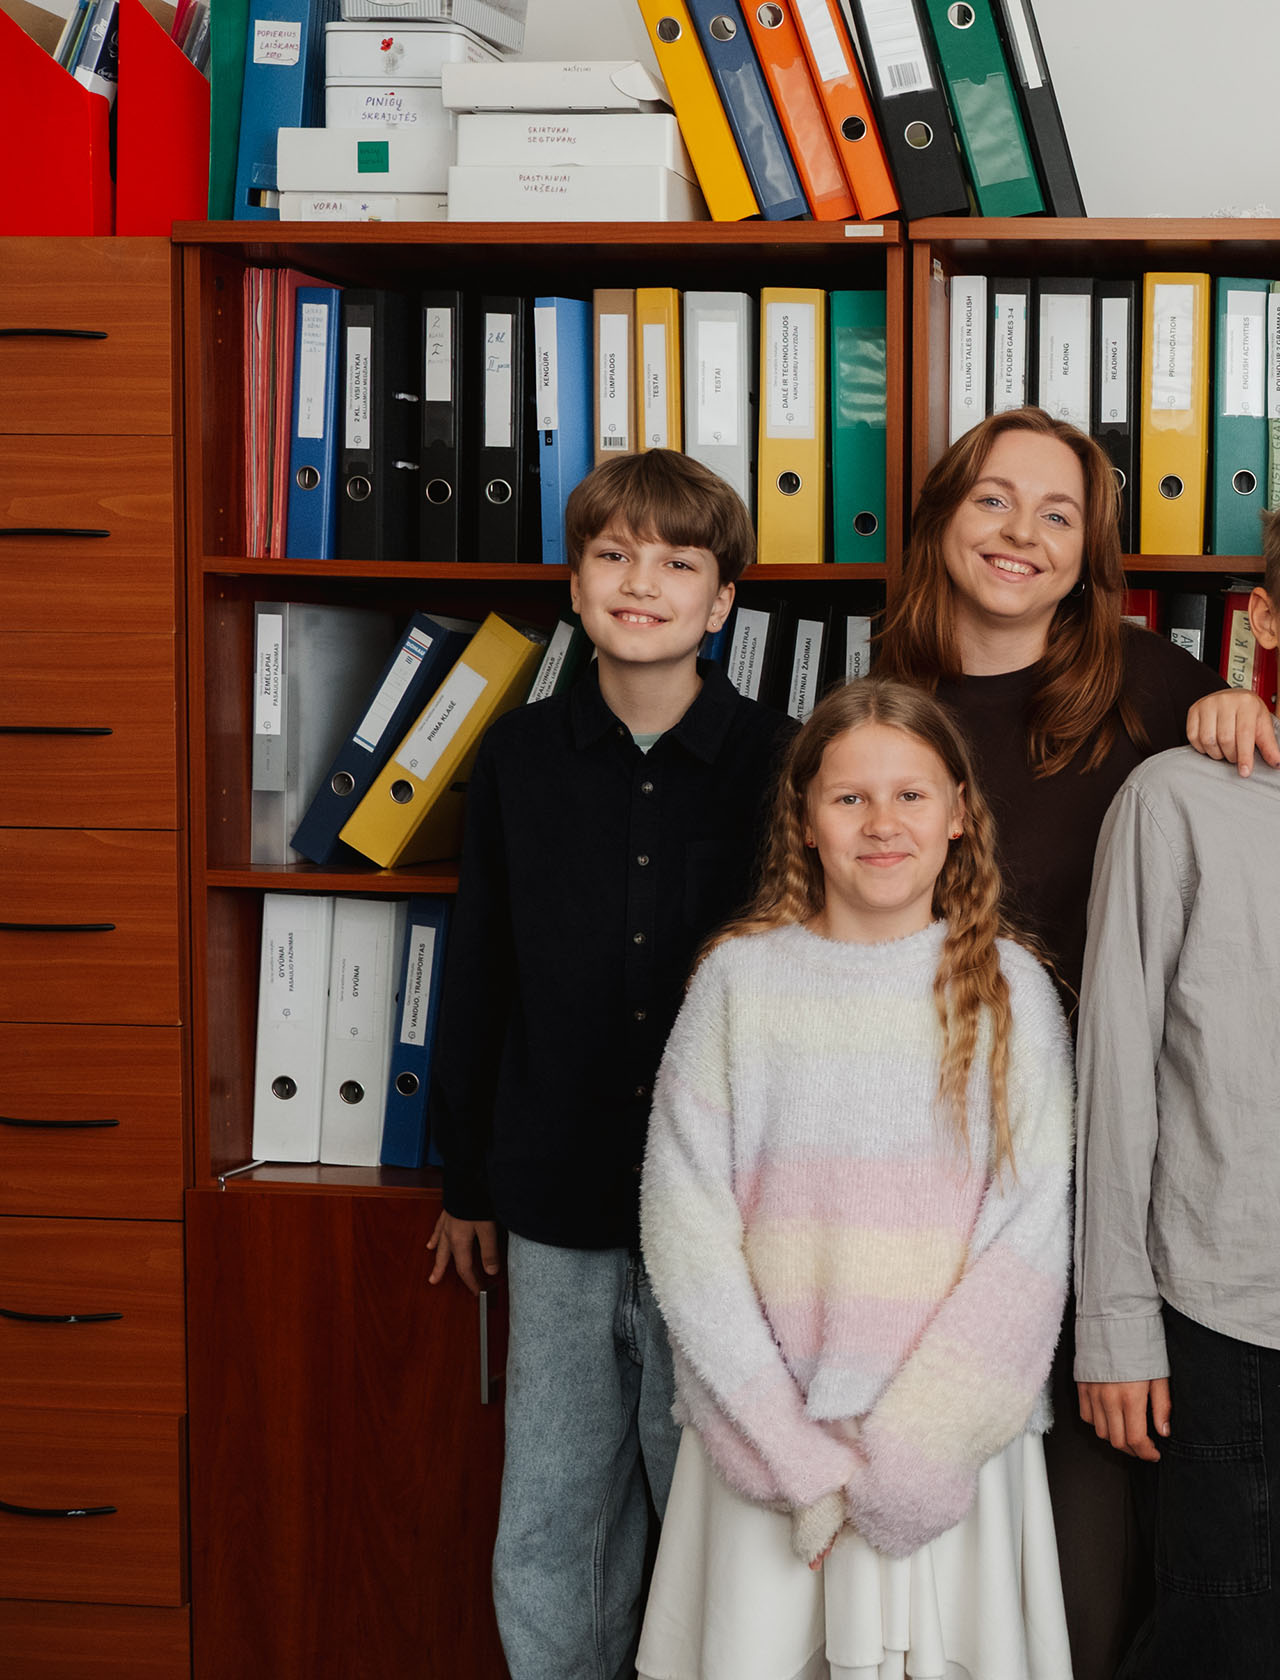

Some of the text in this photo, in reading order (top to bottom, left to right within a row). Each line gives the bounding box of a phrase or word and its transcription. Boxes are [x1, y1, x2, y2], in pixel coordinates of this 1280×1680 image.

[361, 112, 417, 122] SKRAJUTĖS
[365, 97, 402, 111] PINIGŲ
[781, 314, 790, 377] TECHNOLOGIJOS
[965, 295, 974, 392] TELLING TALES IN ENGLISH
[1062, 342, 1070, 376] READING
[1168, 315, 1178, 379] PRONUNCIATION
[1241, 316, 1251, 390] ENGLISH ACTIVITIES
[354, 353, 362, 385] DALYKAI
[608, 352, 616, 399] OLIMPIADOS
[1006, 347, 1014, 376] FOLDER
[1110, 346, 1119, 380] READING
[652, 373, 660, 398] TESTAI
[714, 367, 722, 393] TESTAI
[782, 378, 789, 386] IR
[1005, 376, 1013, 394] FILE
[271, 642, 280, 675] PAŽINIMAS
[740, 626, 751, 660] CENTRAS
[801, 637, 812, 671] ŽAIDIMAI
[262, 652, 271, 695] ŽEMĖLAPIAI
[426, 721, 443, 742] PIRMA
[440, 700, 457, 723] KLASĖ
[277, 946, 286, 979] GYVŪNAI
[414, 943, 426, 994] TRANSPORTAS
[352, 965, 361, 998] GYVŪNAI
